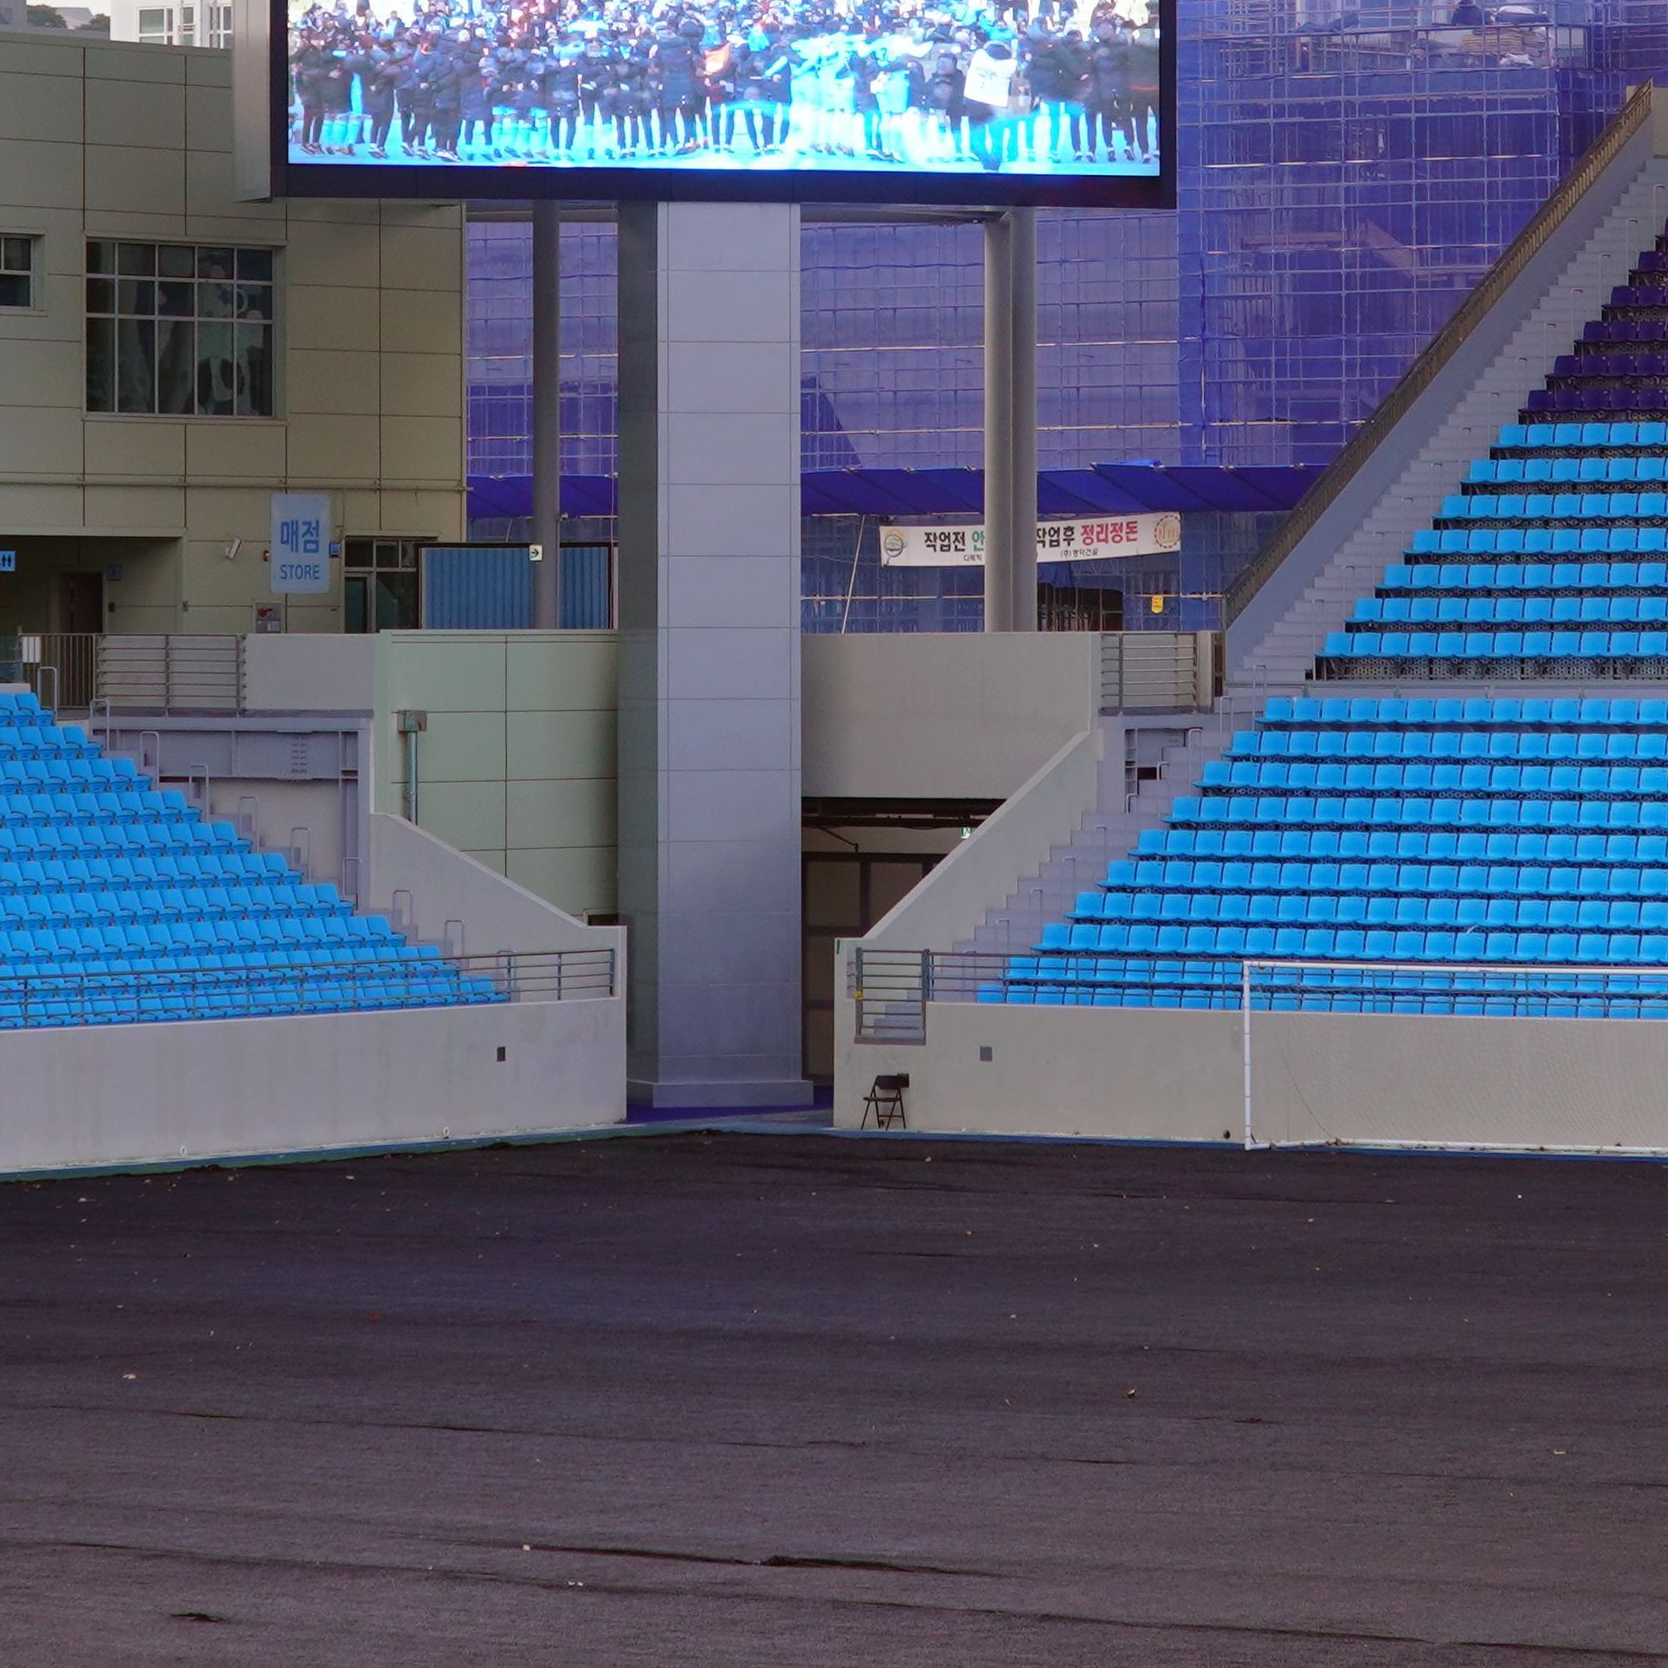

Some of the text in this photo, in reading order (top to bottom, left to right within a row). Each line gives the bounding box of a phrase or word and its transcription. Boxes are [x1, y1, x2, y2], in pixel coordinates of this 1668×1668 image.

[280, 519, 320, 553] 매점
[924, 531, 966, 552] 작업전
[1081, 520, 1138, 546] 정리정돈
[280, 564, 320, 580] STORE
